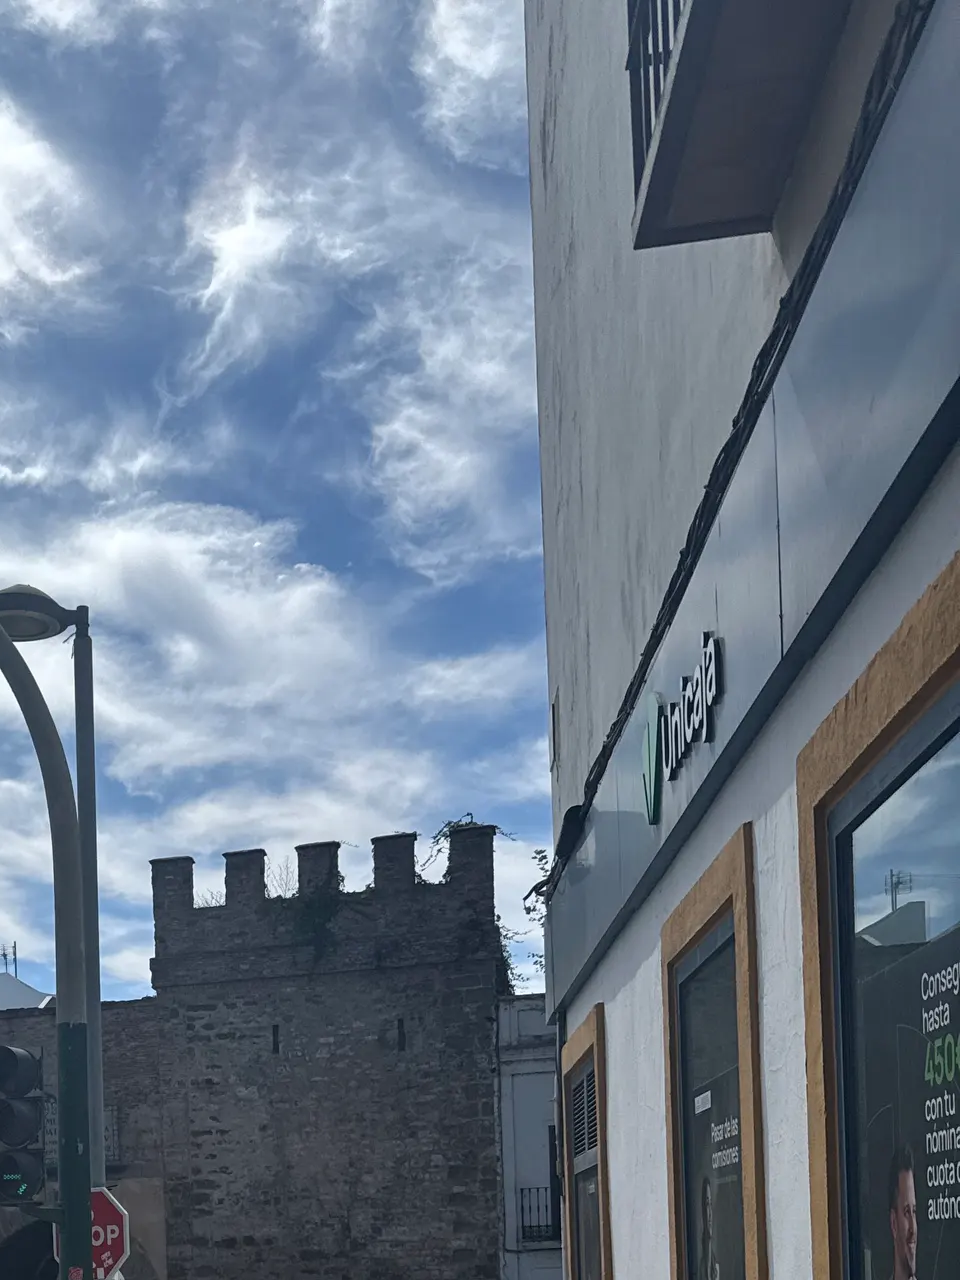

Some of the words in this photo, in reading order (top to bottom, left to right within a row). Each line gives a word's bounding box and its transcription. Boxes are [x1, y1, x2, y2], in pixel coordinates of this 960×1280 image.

[661, 632, 716, 781] Unicaja
[921, 961, 960, 1001] Conseg
[922, 1000, 951, 1035] hasta
[924, 1096, 943, 1121] con
[944, 1090, 956, 1117] tu
[926, 1158, 956, 1188] cuota
[91, 1224, 120, 1247] OP
